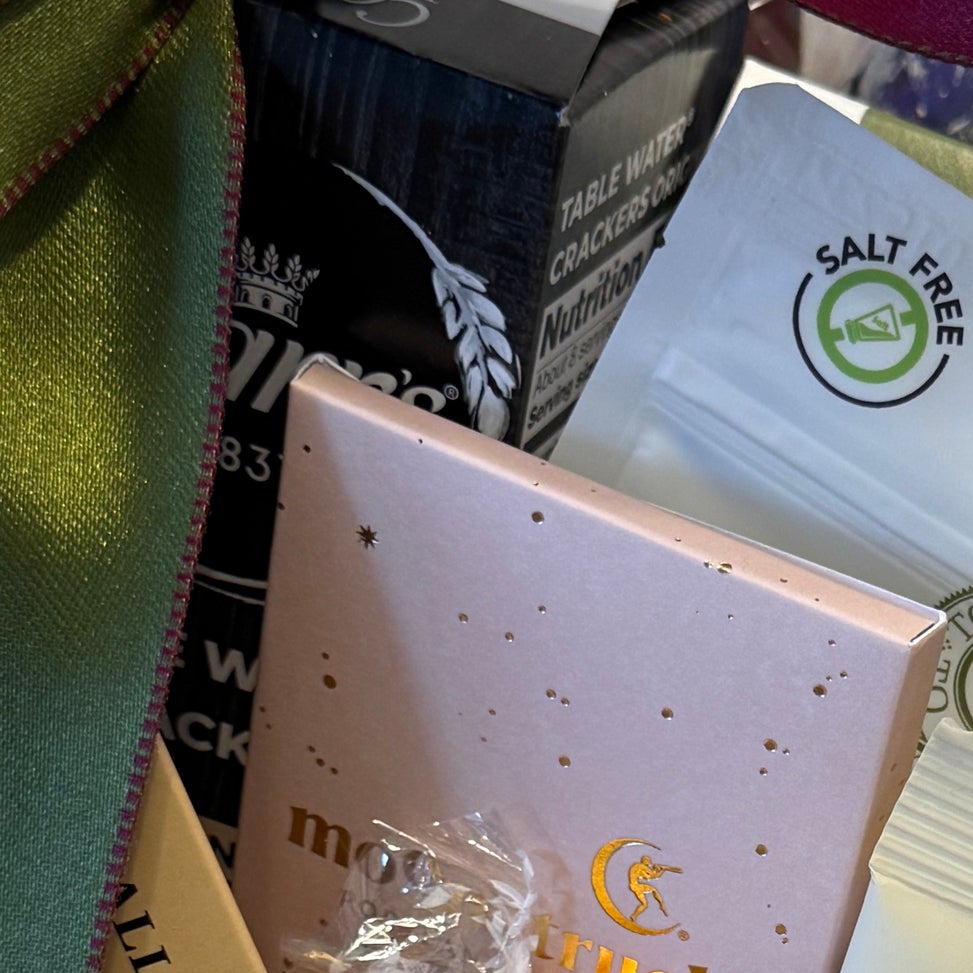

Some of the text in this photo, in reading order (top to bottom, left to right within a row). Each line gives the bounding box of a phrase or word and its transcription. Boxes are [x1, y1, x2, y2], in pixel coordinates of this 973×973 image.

[560, 115, 687, 232] TABLE WATER
[549, 186, 651, 286] CRACKERS
[816, 233, 964, 346] SALT FREE
[539, 251, 644, 361] Nutrition
